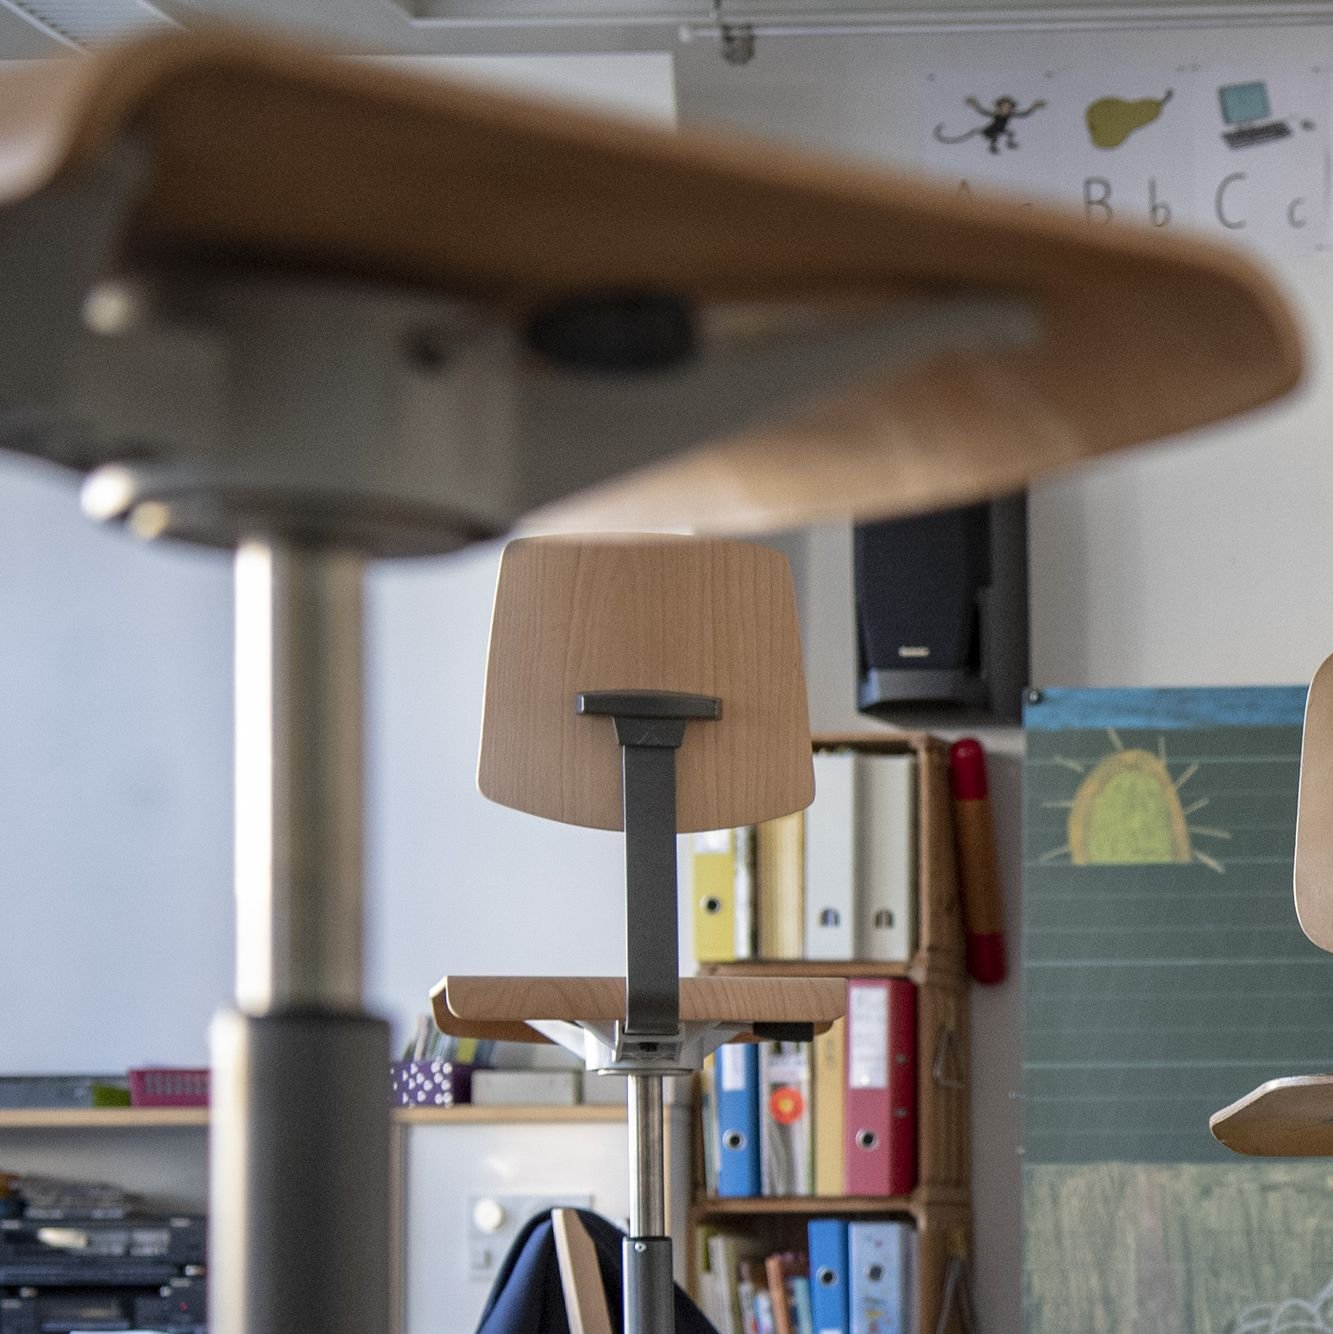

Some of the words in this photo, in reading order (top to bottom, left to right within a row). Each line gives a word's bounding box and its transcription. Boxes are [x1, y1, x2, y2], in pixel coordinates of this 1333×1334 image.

[1084, 177, 1111, 226] B
[1148, 178, 1171, 227] b
[1214, 173, 1248, 229] C
[1286, 196, 1306, 228] c
